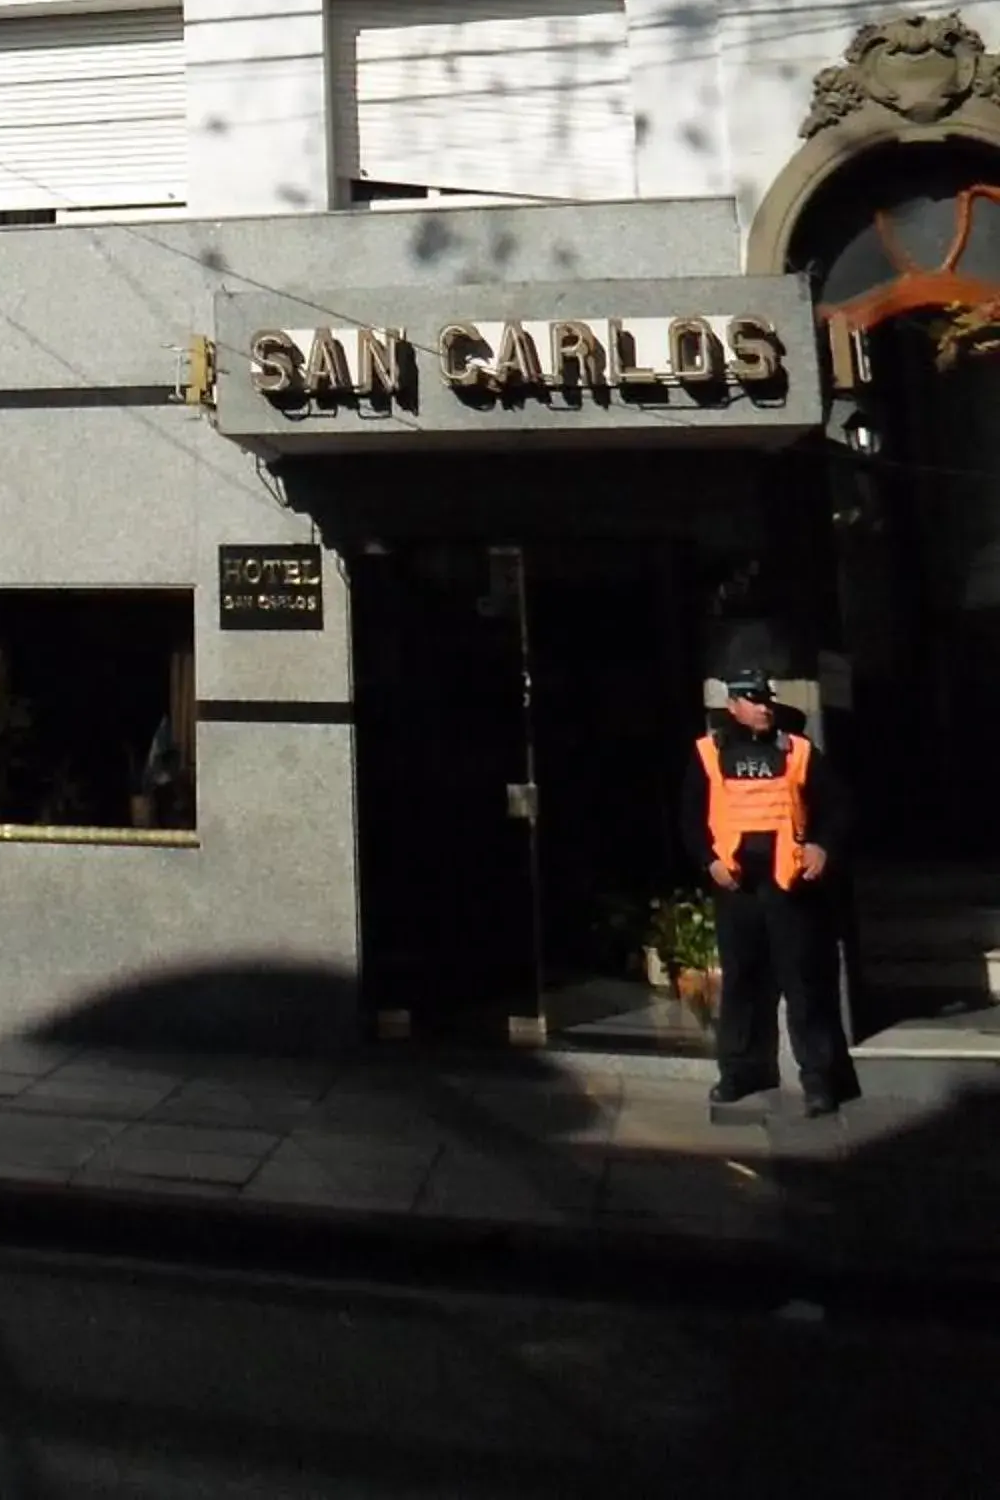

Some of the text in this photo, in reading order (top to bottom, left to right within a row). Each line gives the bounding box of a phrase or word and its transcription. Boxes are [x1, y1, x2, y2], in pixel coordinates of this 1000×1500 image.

[252, 314, 780, 393] SAN CARLOS
[224, 559, 320, 584] HOTEL
[735, 760, 773, 778] PFA
